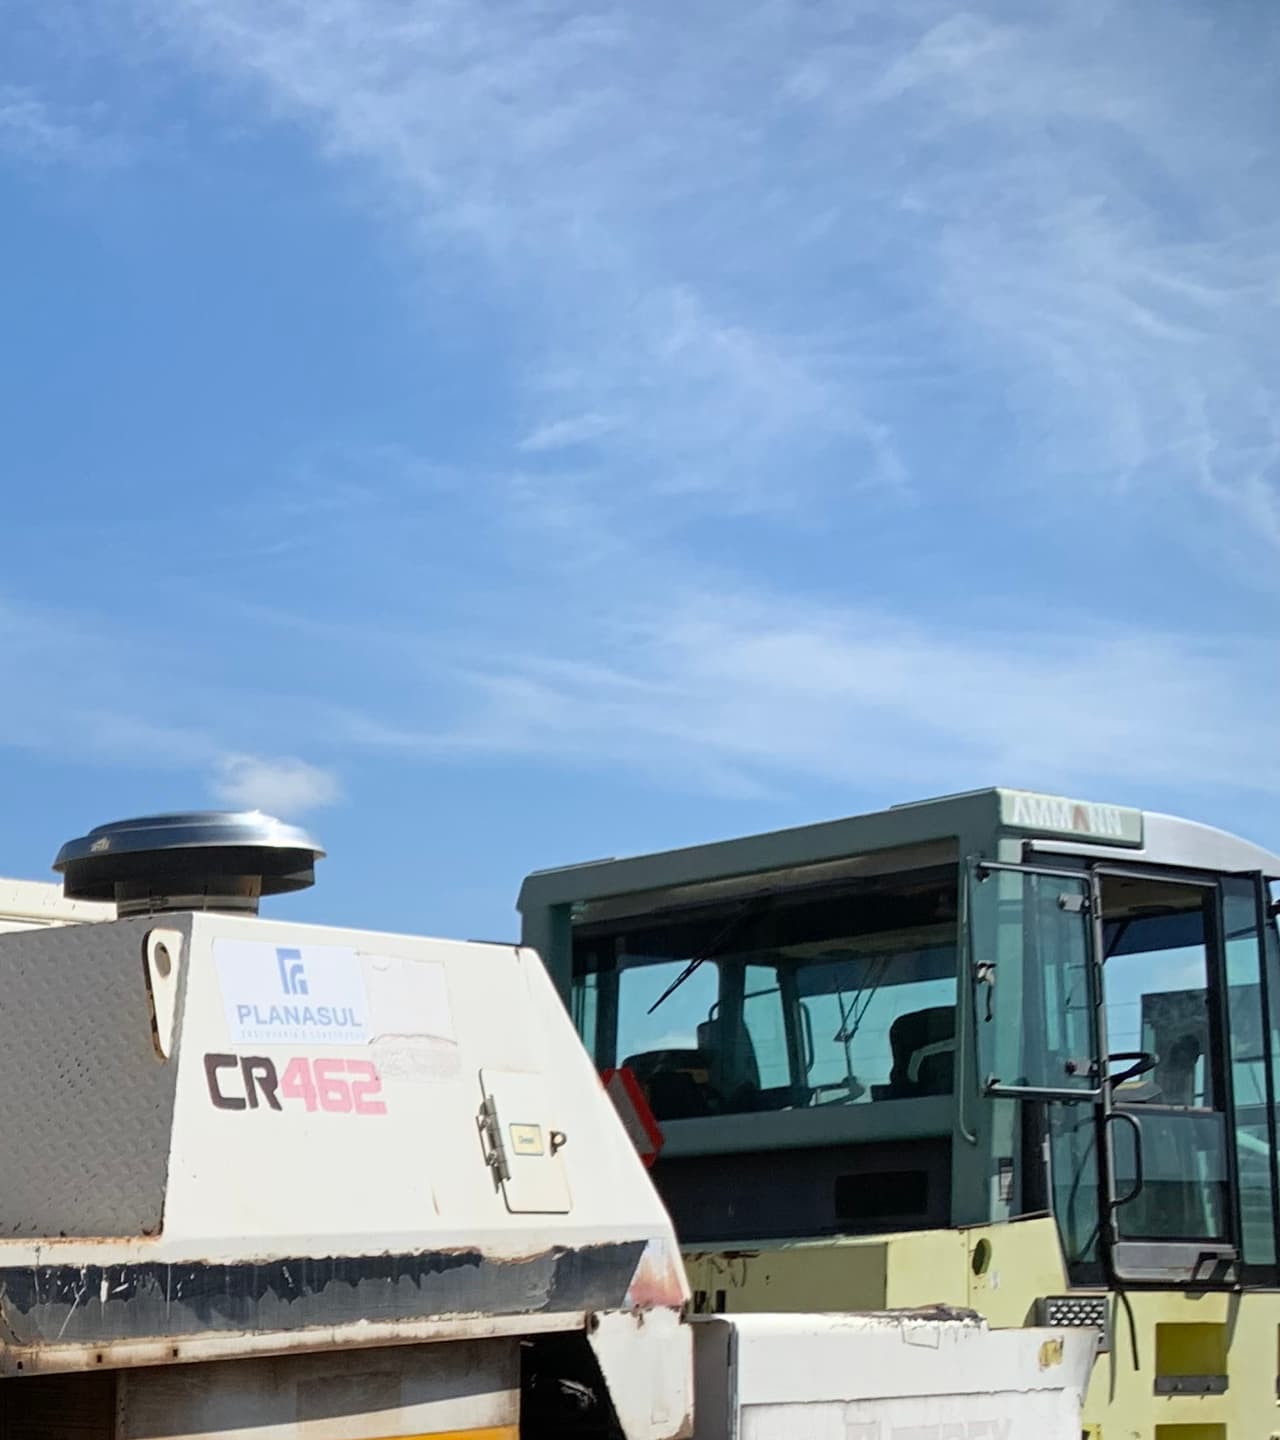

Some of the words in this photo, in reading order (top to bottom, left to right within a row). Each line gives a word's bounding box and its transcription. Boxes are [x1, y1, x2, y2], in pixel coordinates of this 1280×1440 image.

[1013, 797, 1123, 836] AMMANN
[236, 1004, 363, 1028] PLANASUL
[204, 1053, 388, 1115] CR462
